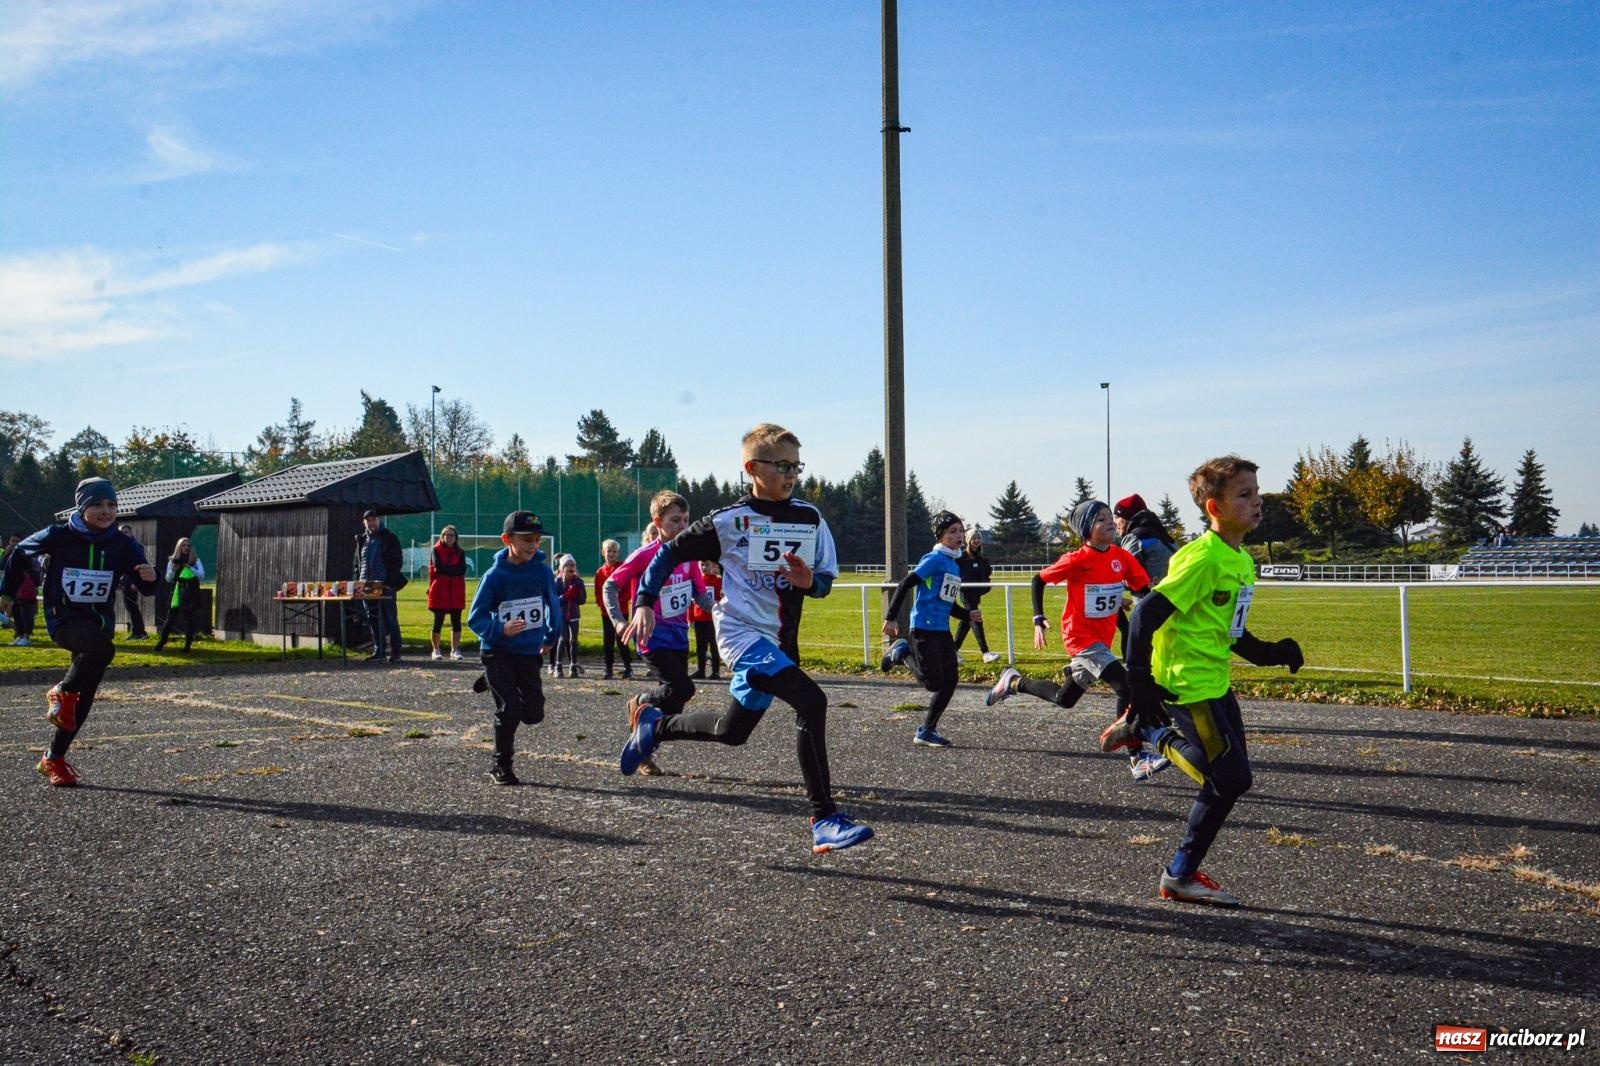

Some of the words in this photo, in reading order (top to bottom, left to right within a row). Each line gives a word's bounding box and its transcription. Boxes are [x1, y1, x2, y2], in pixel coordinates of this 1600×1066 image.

[763, 540, 802, 562] 57
[65, 580, 109, 597] 125
[744, 570, 793, 591] Jee
[670, 593, 688, 610] 63
[1095, 595, 1117, 611] 55
[1236, 604, 1250, 627] 1
